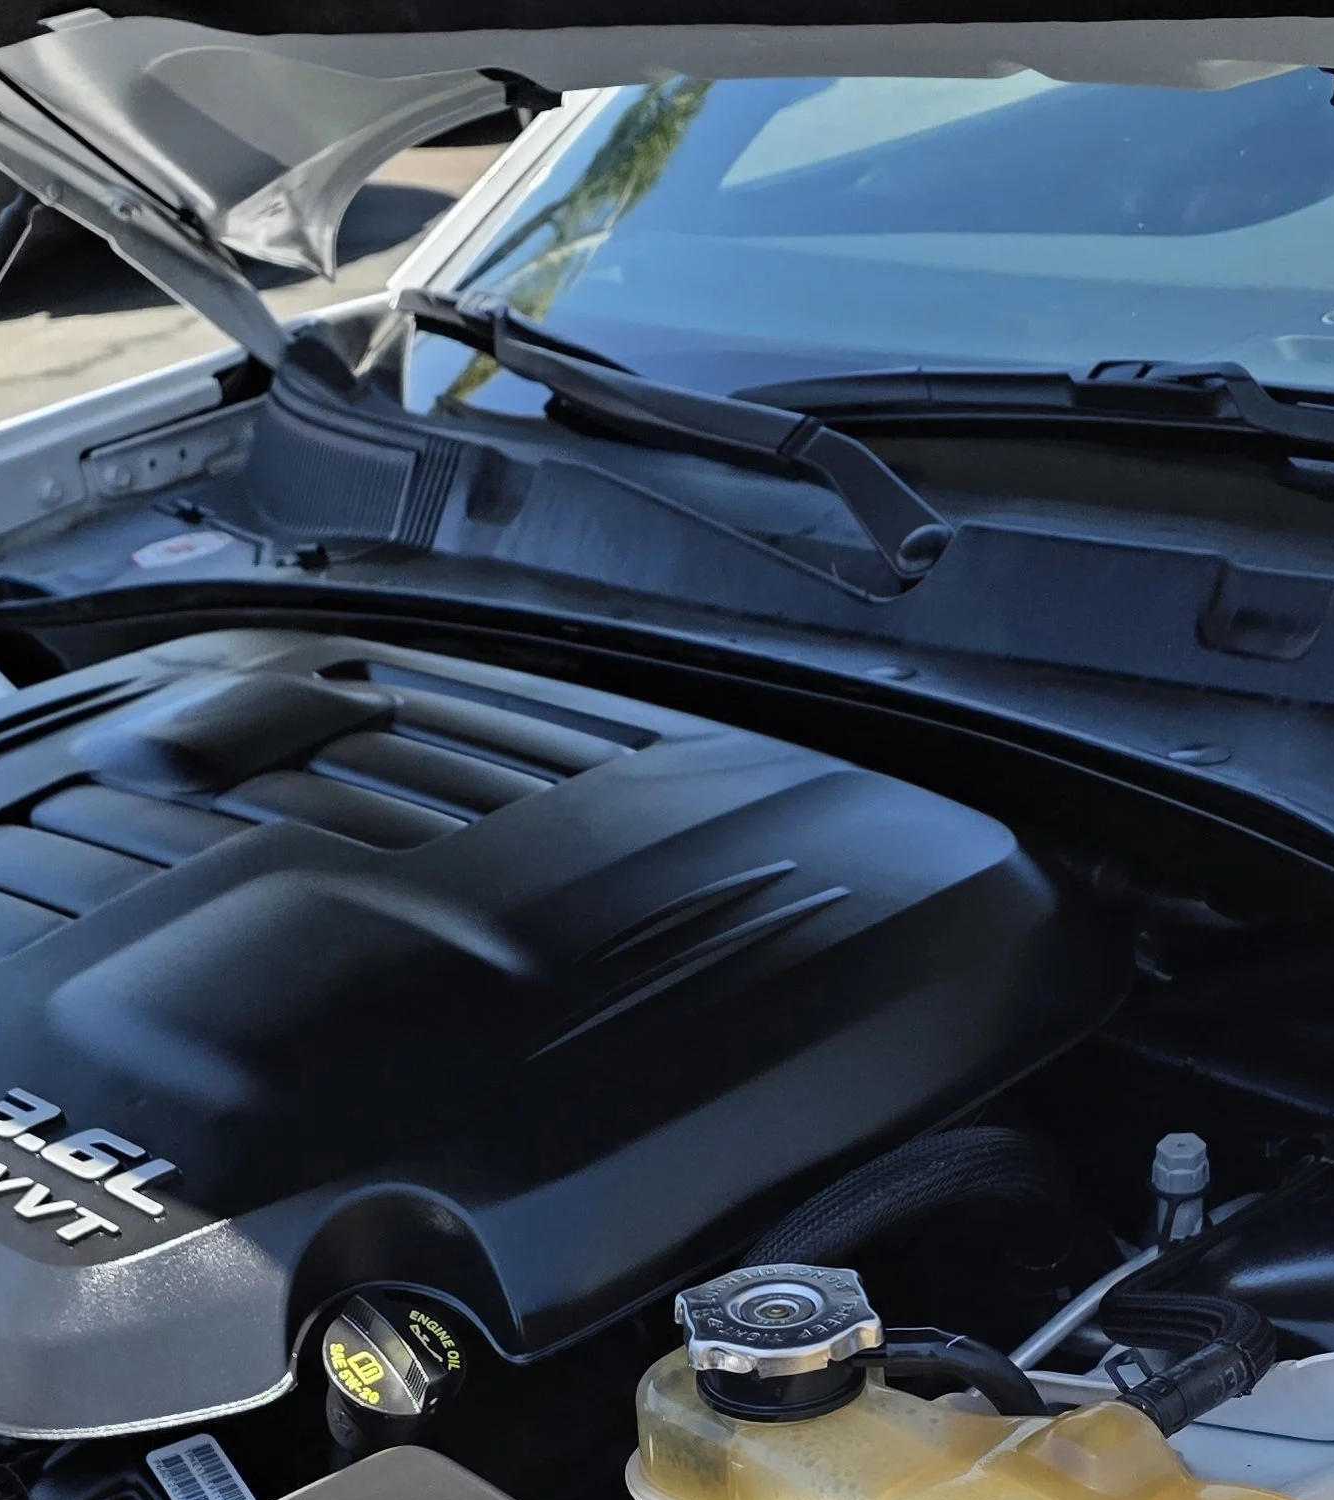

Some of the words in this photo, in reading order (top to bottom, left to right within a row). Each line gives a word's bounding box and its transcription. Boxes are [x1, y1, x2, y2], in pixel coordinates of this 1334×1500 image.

[329, 1343, 349, 1370] SAE
[408, 1309, 456, 1349] ENGINE
[446, 1350, 461, 1372] OIL
[338, 1369, 380, 1405] 5W-20
